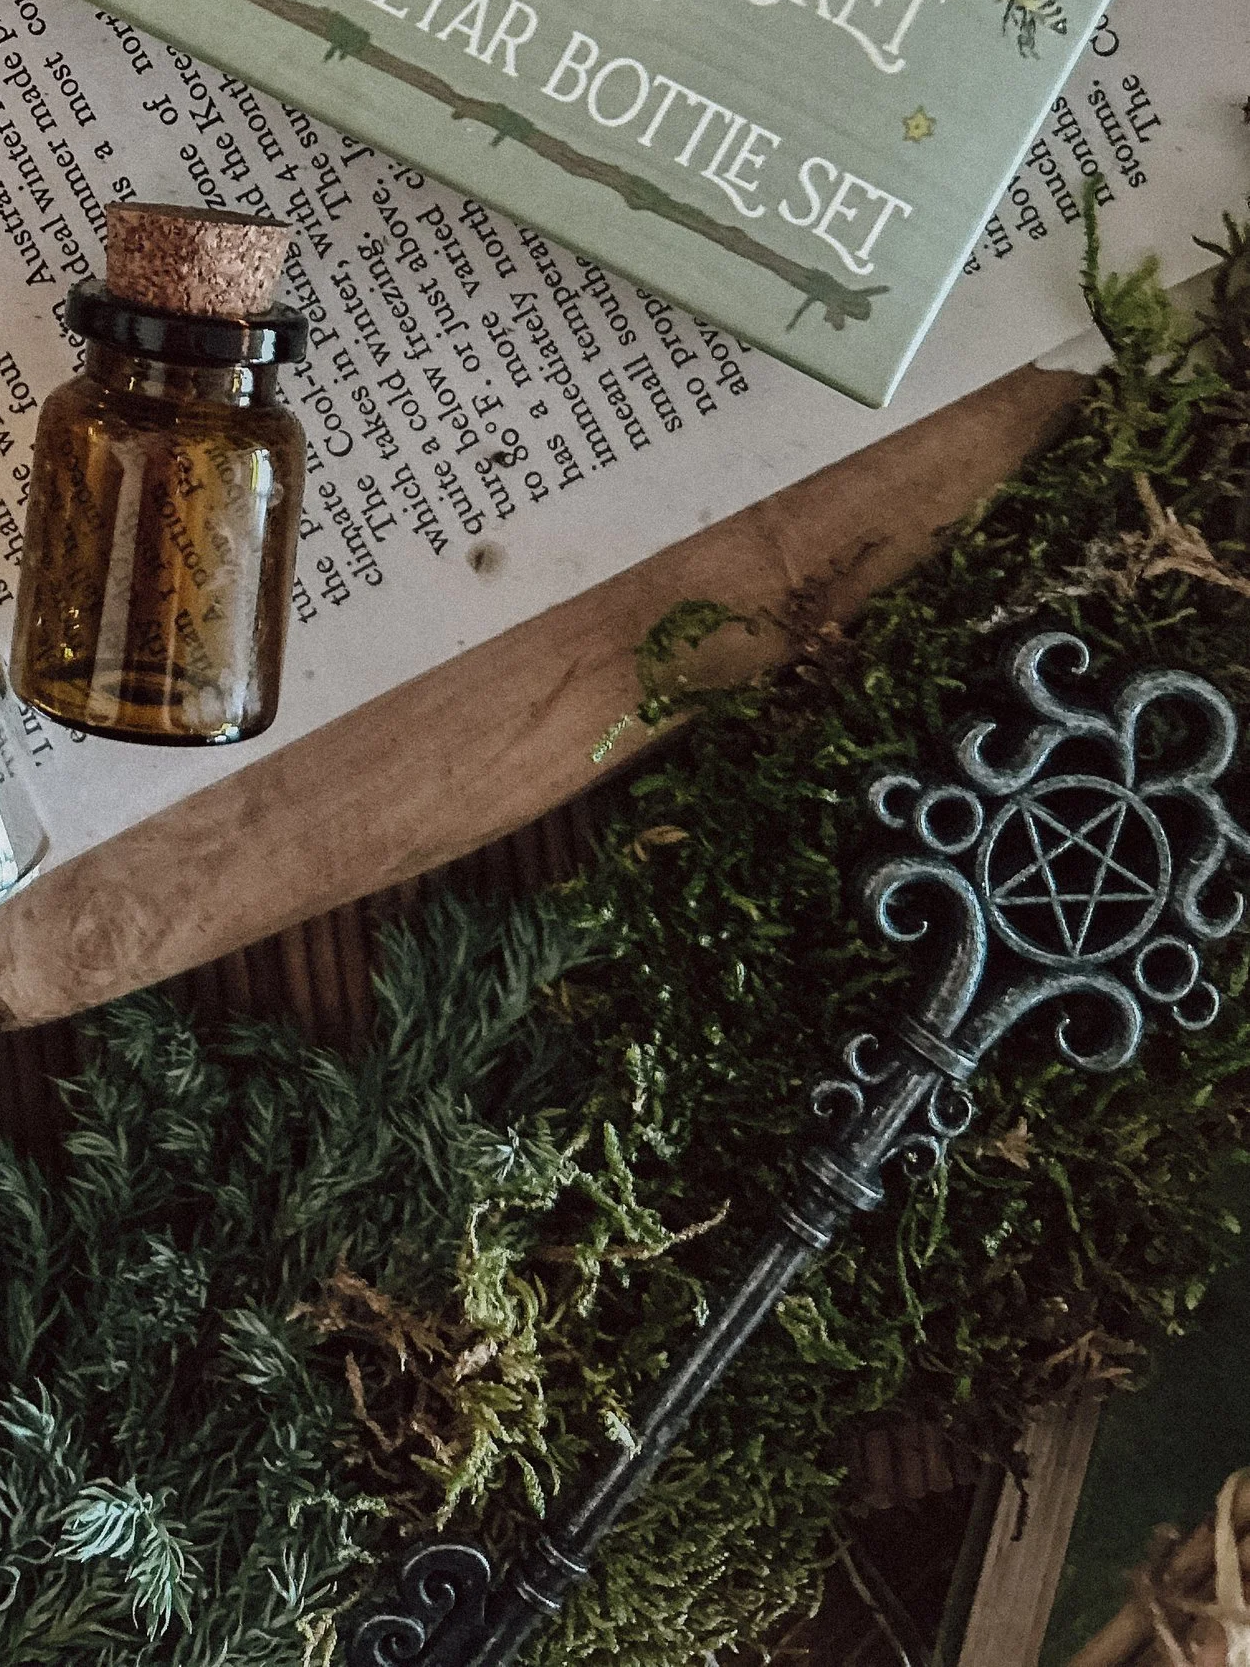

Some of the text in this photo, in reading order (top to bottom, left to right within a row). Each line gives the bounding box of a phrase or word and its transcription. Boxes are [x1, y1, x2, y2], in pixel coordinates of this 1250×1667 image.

[1, 50, 58, 134] made
[42, 50, 137, 209] is most
[141, 92, 179, 126] of
[1086, 78, 1148, 189] storms.
[1120, 73, 1162, 144] The
[178, 142, 227, 214] zone
[214, 130, 251, 183] the
[521, 30, 782, 218] BOTTLE
[777, 155, 913, 275] SET
[302, 151, 481, 456] below freezing. The
[371, 176, 481, 373] or just above.
[283, 185, 487, 536] quite cold winter, with
[331, 345, 361, 385] in
[414, 201, 586, 491] has more varied
[508, 291, 619, 472] immediately
[349, 384, 400, 461] takes
[596, 366, 652, 452] mean
[621, 351, 684, 434] small
[317, 480, 384, 587] climate
[355, 473, 398, 543] The
[388, 461, 449, 556] which
